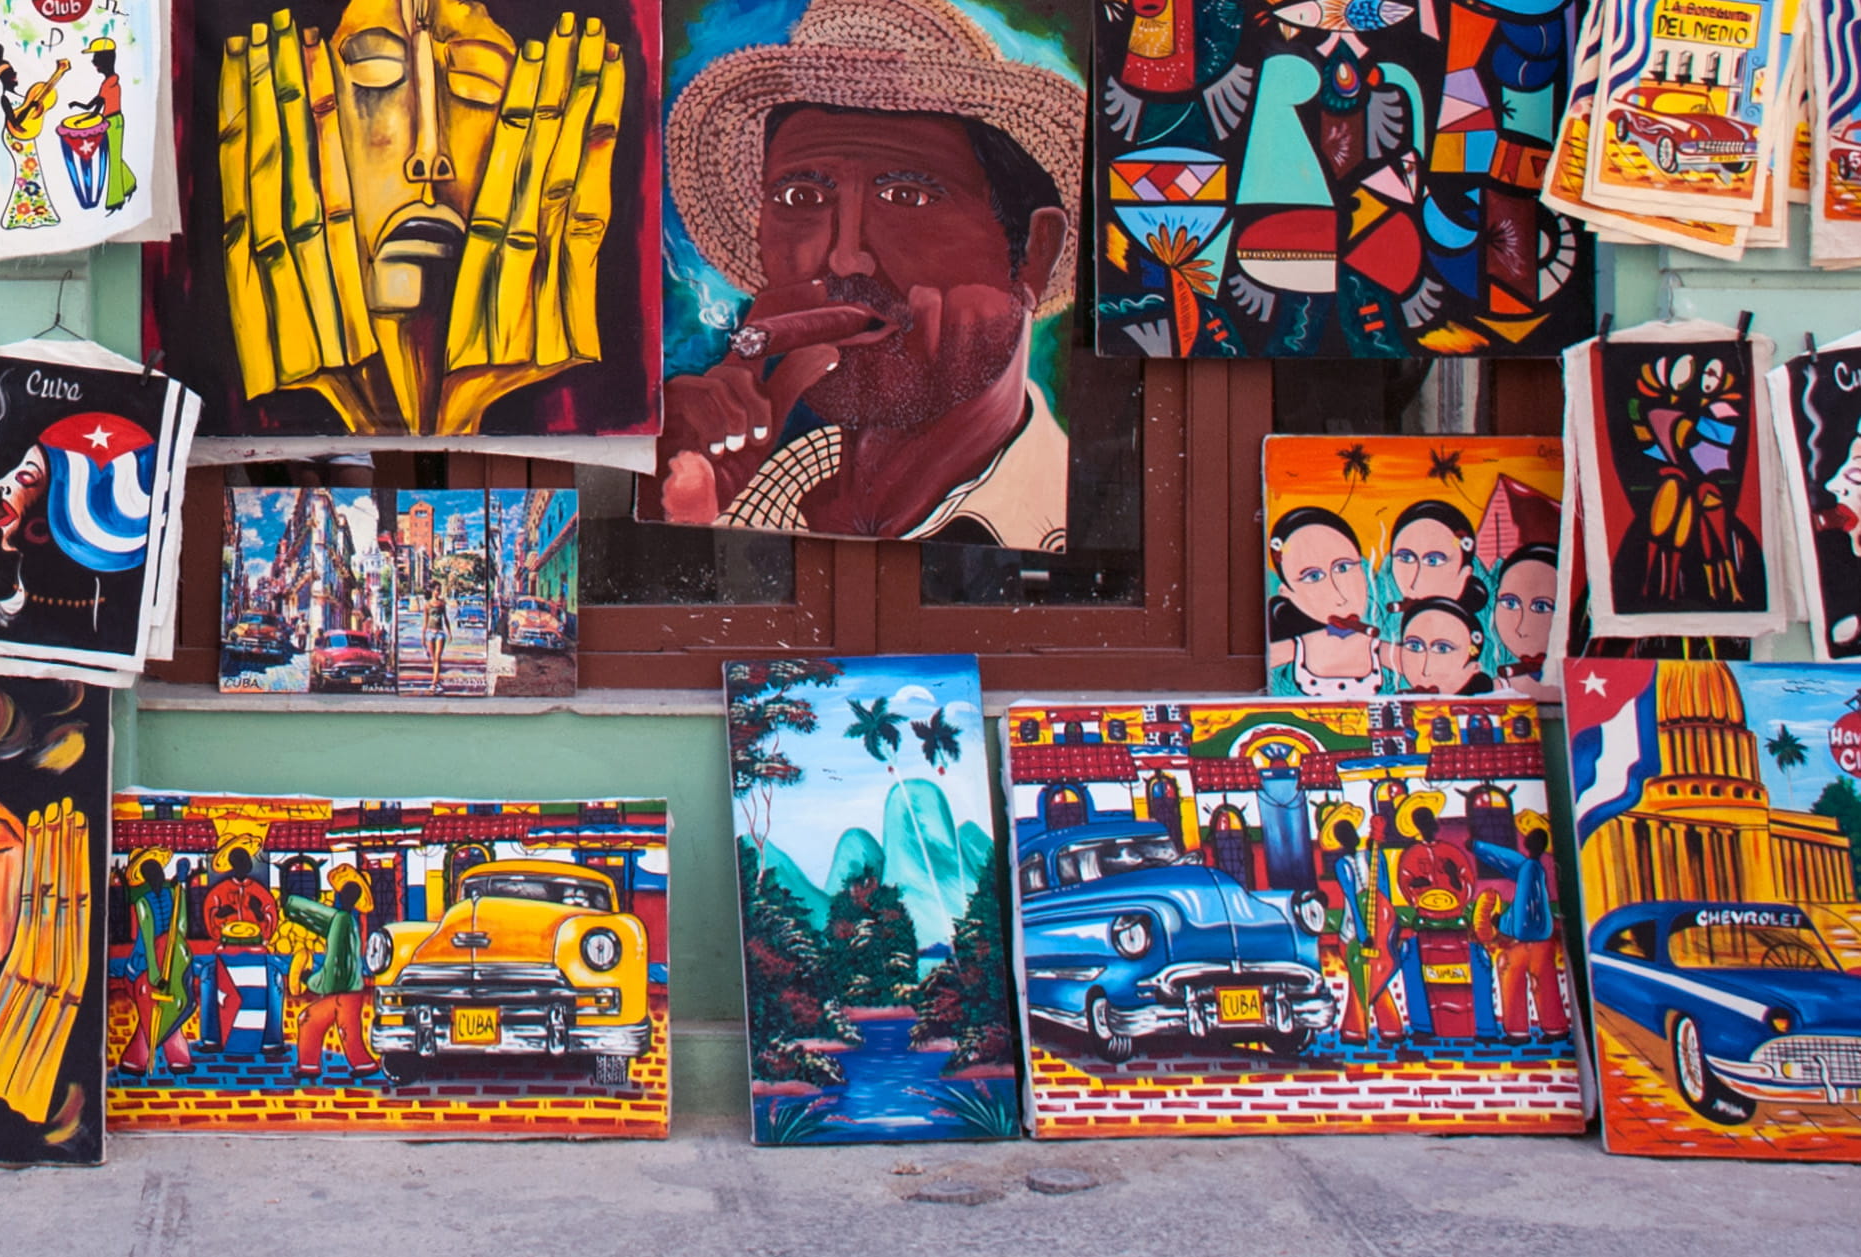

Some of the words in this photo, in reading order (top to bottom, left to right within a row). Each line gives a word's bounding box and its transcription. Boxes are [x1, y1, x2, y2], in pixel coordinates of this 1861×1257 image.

[1657, 14, 1687, 38] DEL
[1693, 20, 1748, 44] MEDIO
[25, 368, 84, 402] Cuba
[1695, 909, 1803, 927] CHEVROLET
[1222, 993, 1259, 1017] CUBA
[458, 1013, 495, 1037] CUBA
